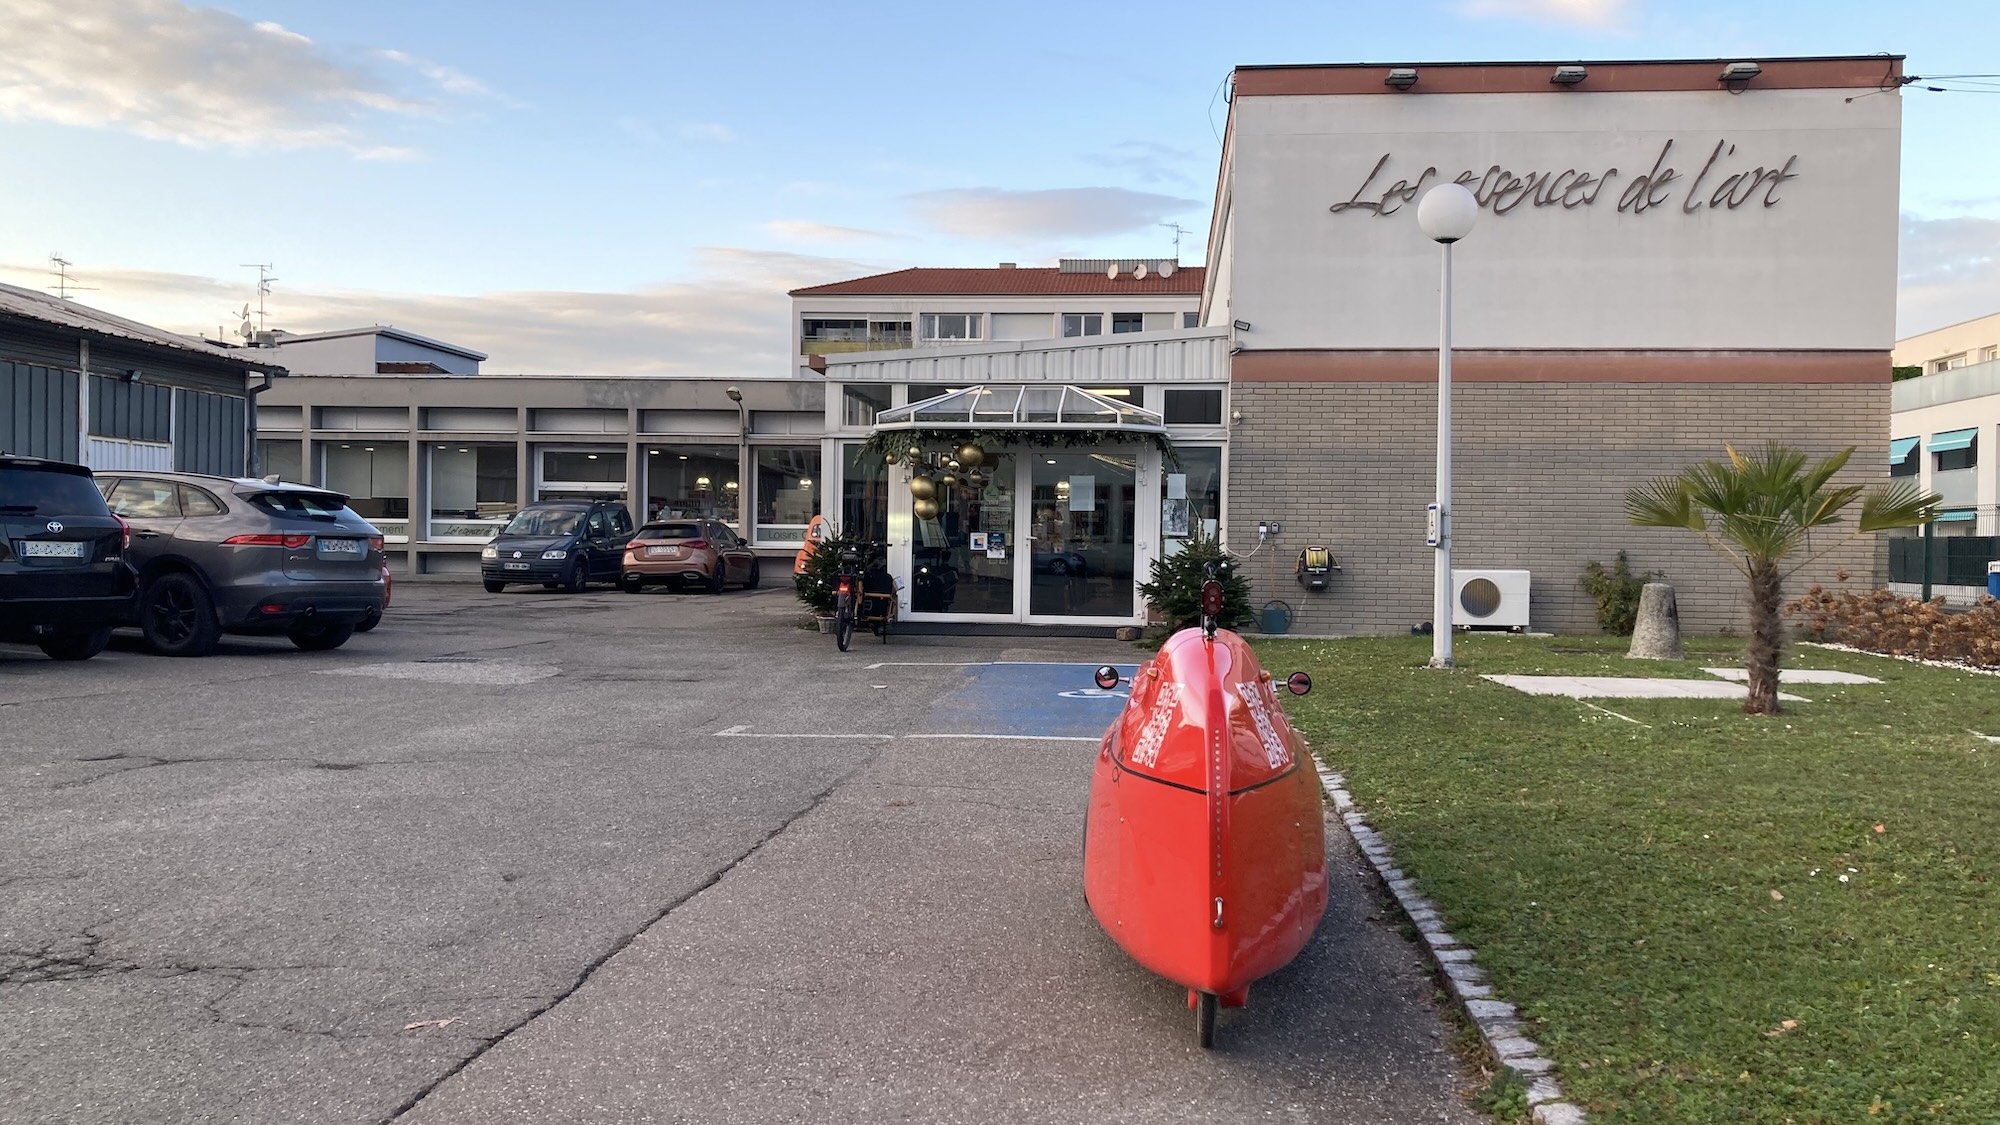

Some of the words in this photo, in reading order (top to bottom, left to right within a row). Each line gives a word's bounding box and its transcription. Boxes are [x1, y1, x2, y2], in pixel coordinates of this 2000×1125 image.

[1329, 153, 1436, 217] Les
[1618, 139, 1683, 214] de
[1683, 139, 1799, 214] l'art
[768, 529, 798, 540] Loisirs
